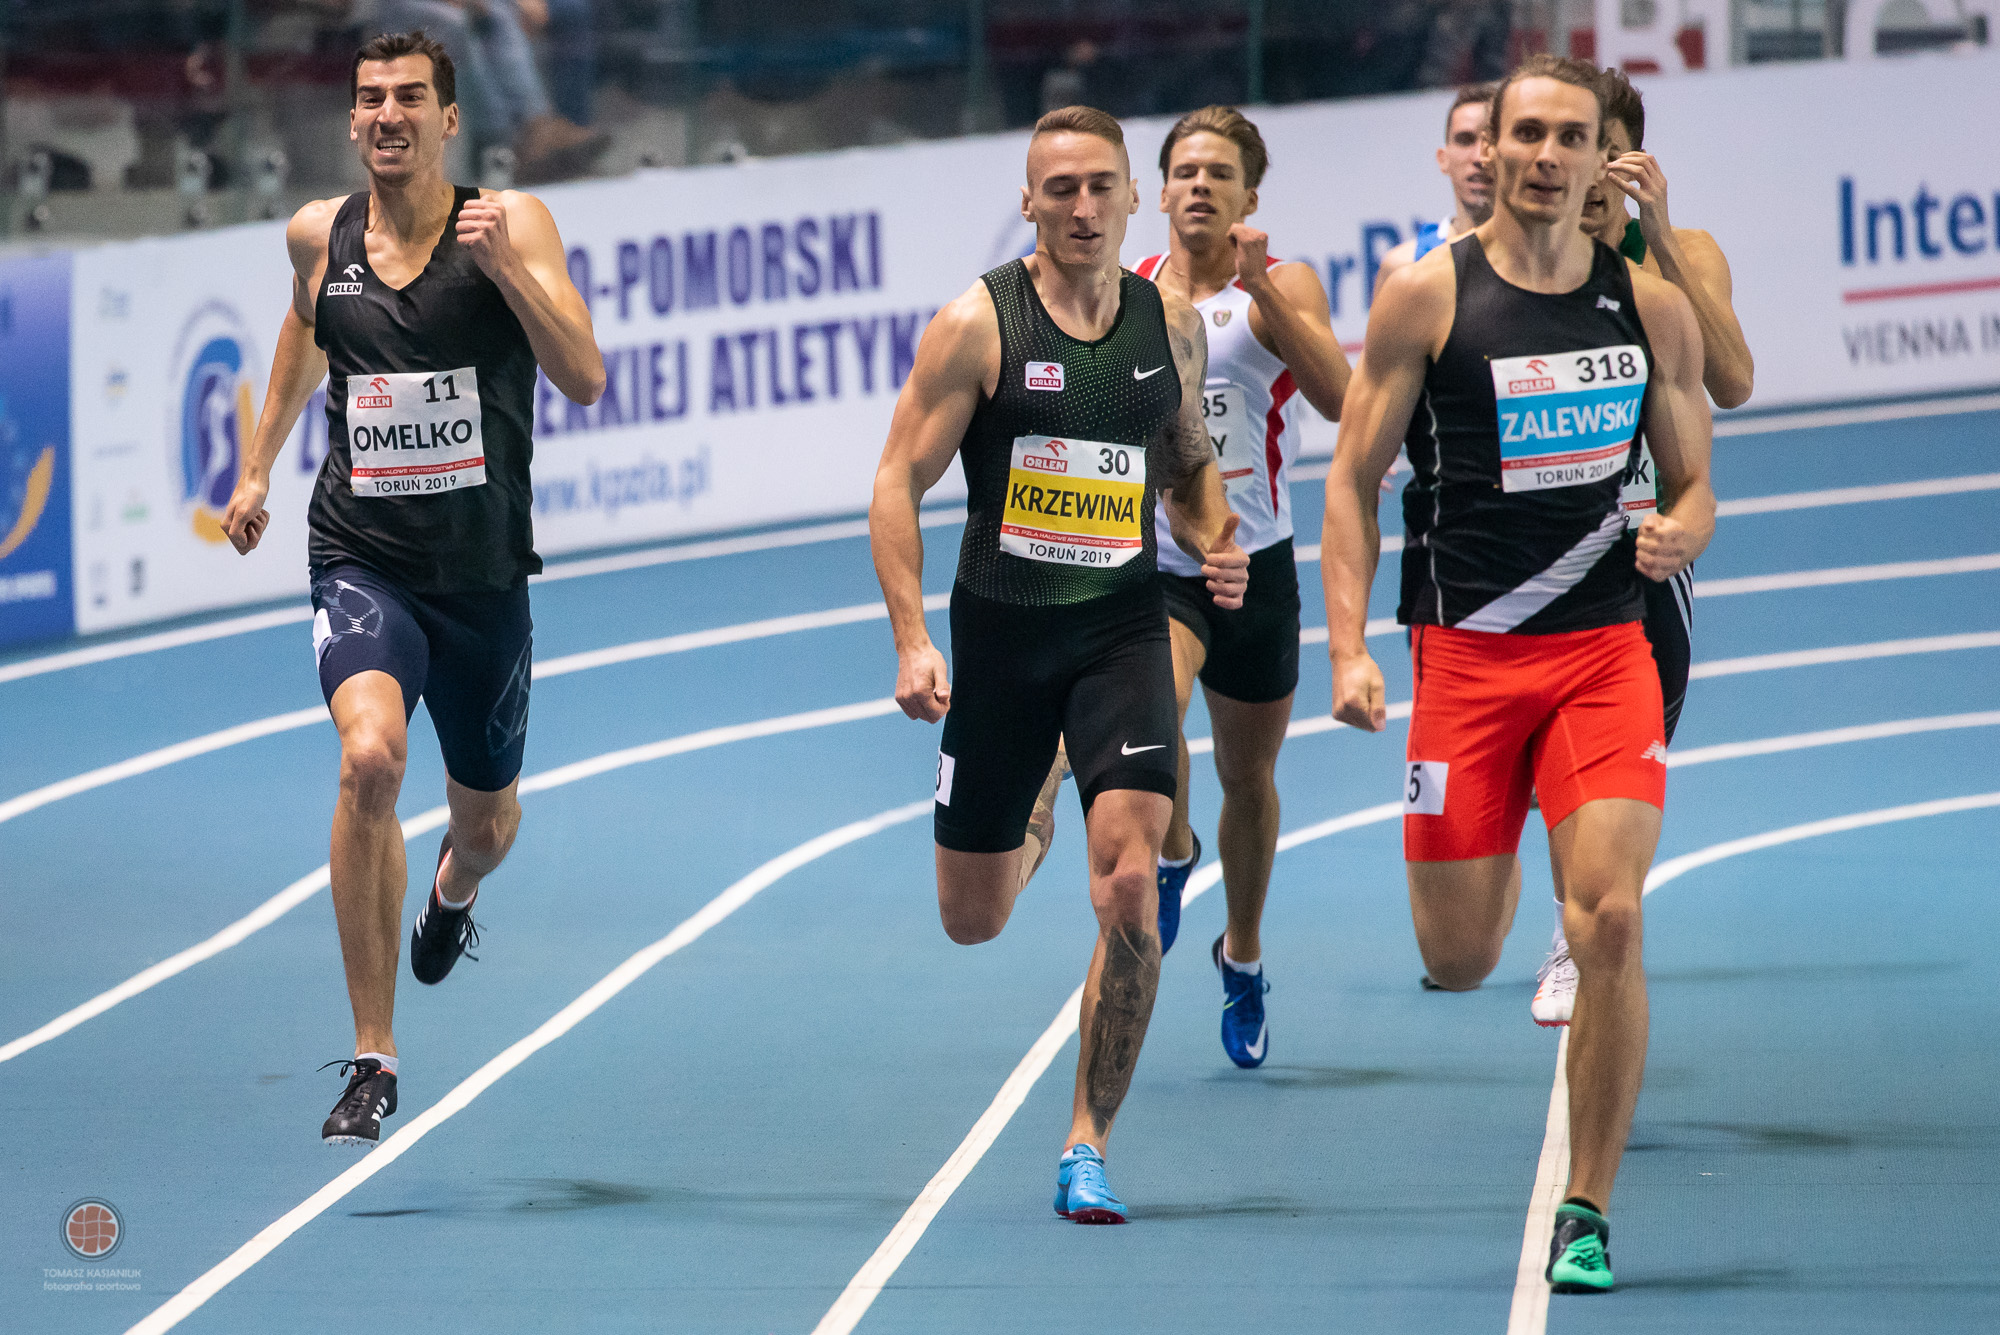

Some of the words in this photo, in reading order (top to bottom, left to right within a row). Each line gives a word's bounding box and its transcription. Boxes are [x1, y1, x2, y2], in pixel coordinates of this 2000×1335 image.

[1841, 178, 2000, 266] Inte
[328, 284, 361, 294] ORLEN
[1842, 318, 1972, 366] VIENNA
[709, 305, 942, 413] ATLETYK
[1576, 352, 1637, 383] 318
[422, 374, 460, 404] 11
[1031, 378, 1060, 387] ORLEN
[1510, 379, 1553, 393] ORLEN
[358, 396, 390, 407] ORLEN
[1501, 397, 1639, 443] ZALEWSKI
[353, 418, 473, 452] OMELKO
[1025, 456, 1066, 472] ORLEN
[1098, 447, 1130, 476] 30
[1535, 464, 1584, 485] TORUŃ
[374, 475, 420, 492] TORUŃ
[424, 475, 457, 491] 2019
[1010, 482, 1135, 523] KRZEWINA
[1029, 542, 1076, 561] TORUŃ
[1080, 550, 1111, 564] 2019
[1408, 764, 1421, 803] 5
